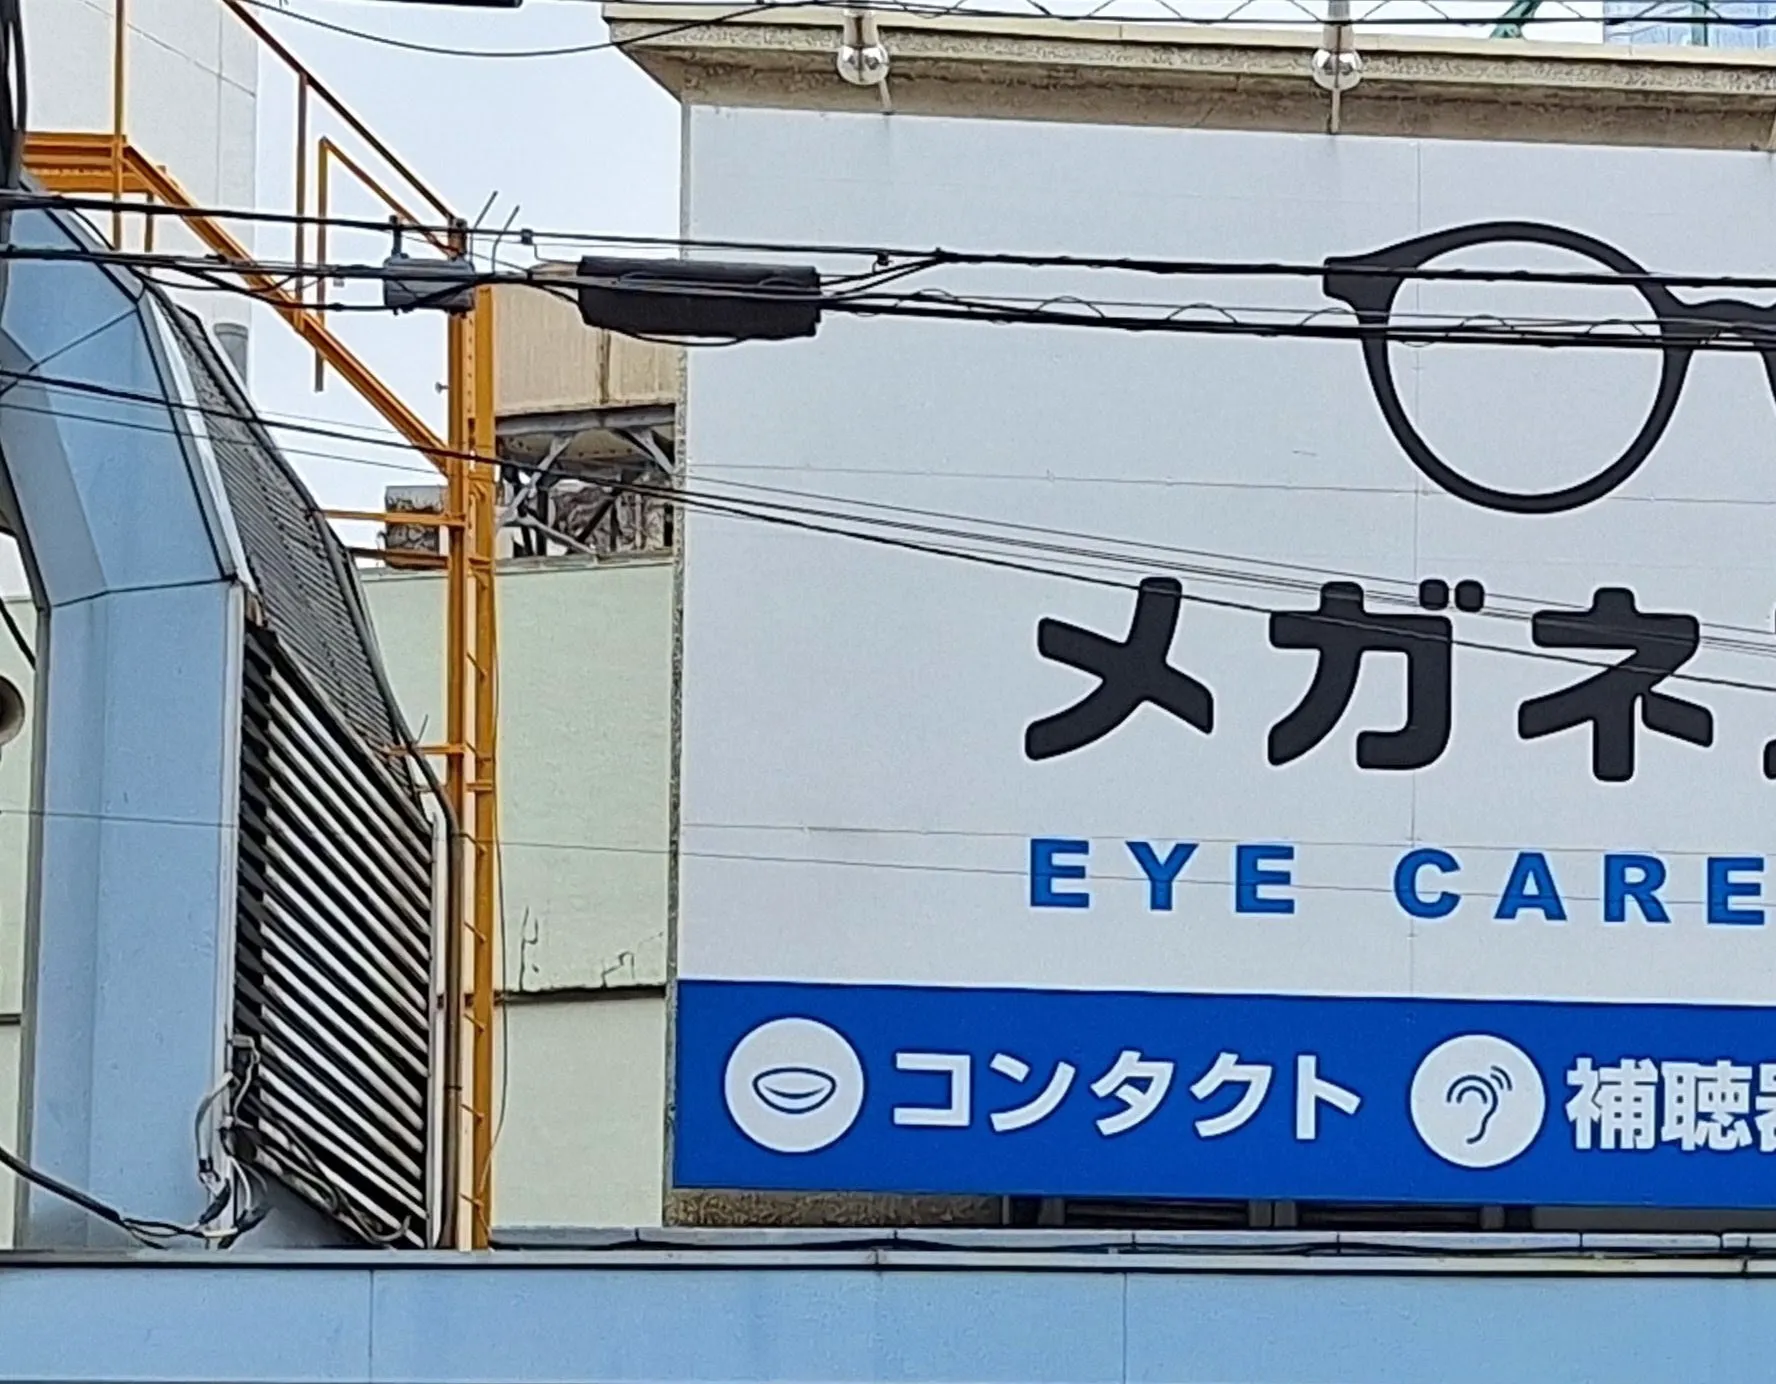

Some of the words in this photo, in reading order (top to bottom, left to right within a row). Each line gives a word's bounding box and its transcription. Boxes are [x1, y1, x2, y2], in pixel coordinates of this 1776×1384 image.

[1029, 838, 1295, 914] EYE
[1394, 848, 1765, 926] CARE
[892, 1049, 1362, 1142] コンタクト
